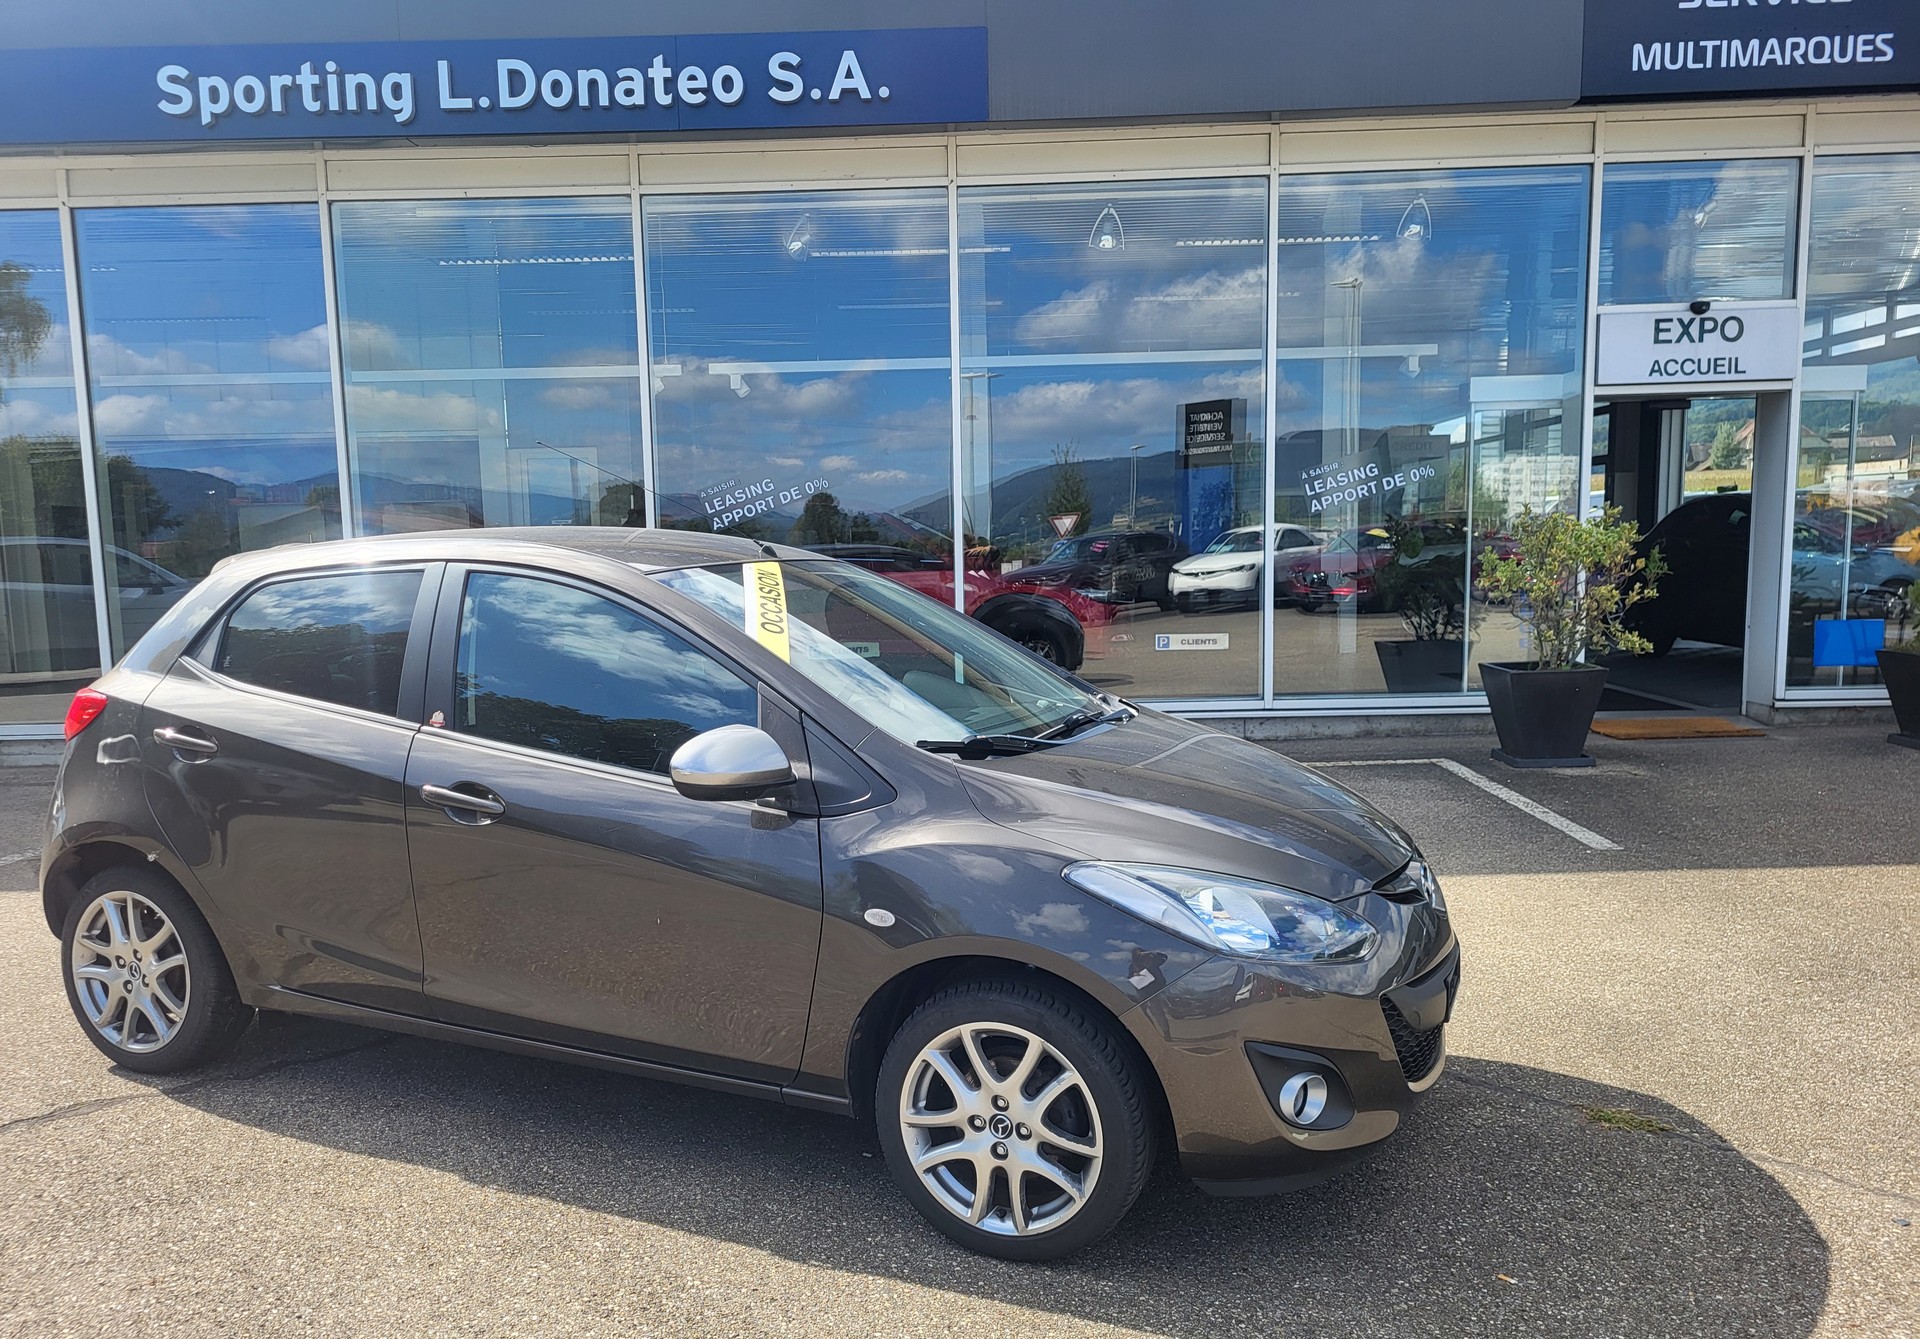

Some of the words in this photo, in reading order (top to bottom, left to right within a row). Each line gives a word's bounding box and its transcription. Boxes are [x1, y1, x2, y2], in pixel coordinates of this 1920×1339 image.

[1632, 33, 1894, 71] MULTIMARQUES
[156, 60, 413, 126] Sporting
[437, 54, 744, 109] L.Donateo
[767, 50, 891, 102] S.A.
[1653, 316, 1744, 344] EXPO
[1648, 357, 1746, 377] ACCUEIL
[1304, 463, 1379, 496] LEASING
[1309, 462, 1338, 477] SAISIR
[704, 478, 775, 514] LEASING
[707, 480, 736, 495] SAISIR
[713, 495, 775, 531] APPORT
[779, 486, 803, 505] DE
[805, 477, 829, 494] 0%
[1310, 480, 1378, 513] APPORT
[1382, 473, 1406, 491] DE
[1410, 465, 1435, 482] 0%
[757, 568, 785, 635] OCCASION
[1160, 637, 1168, 648] P
[1180, 638, 1218, 646] CLIENTS
